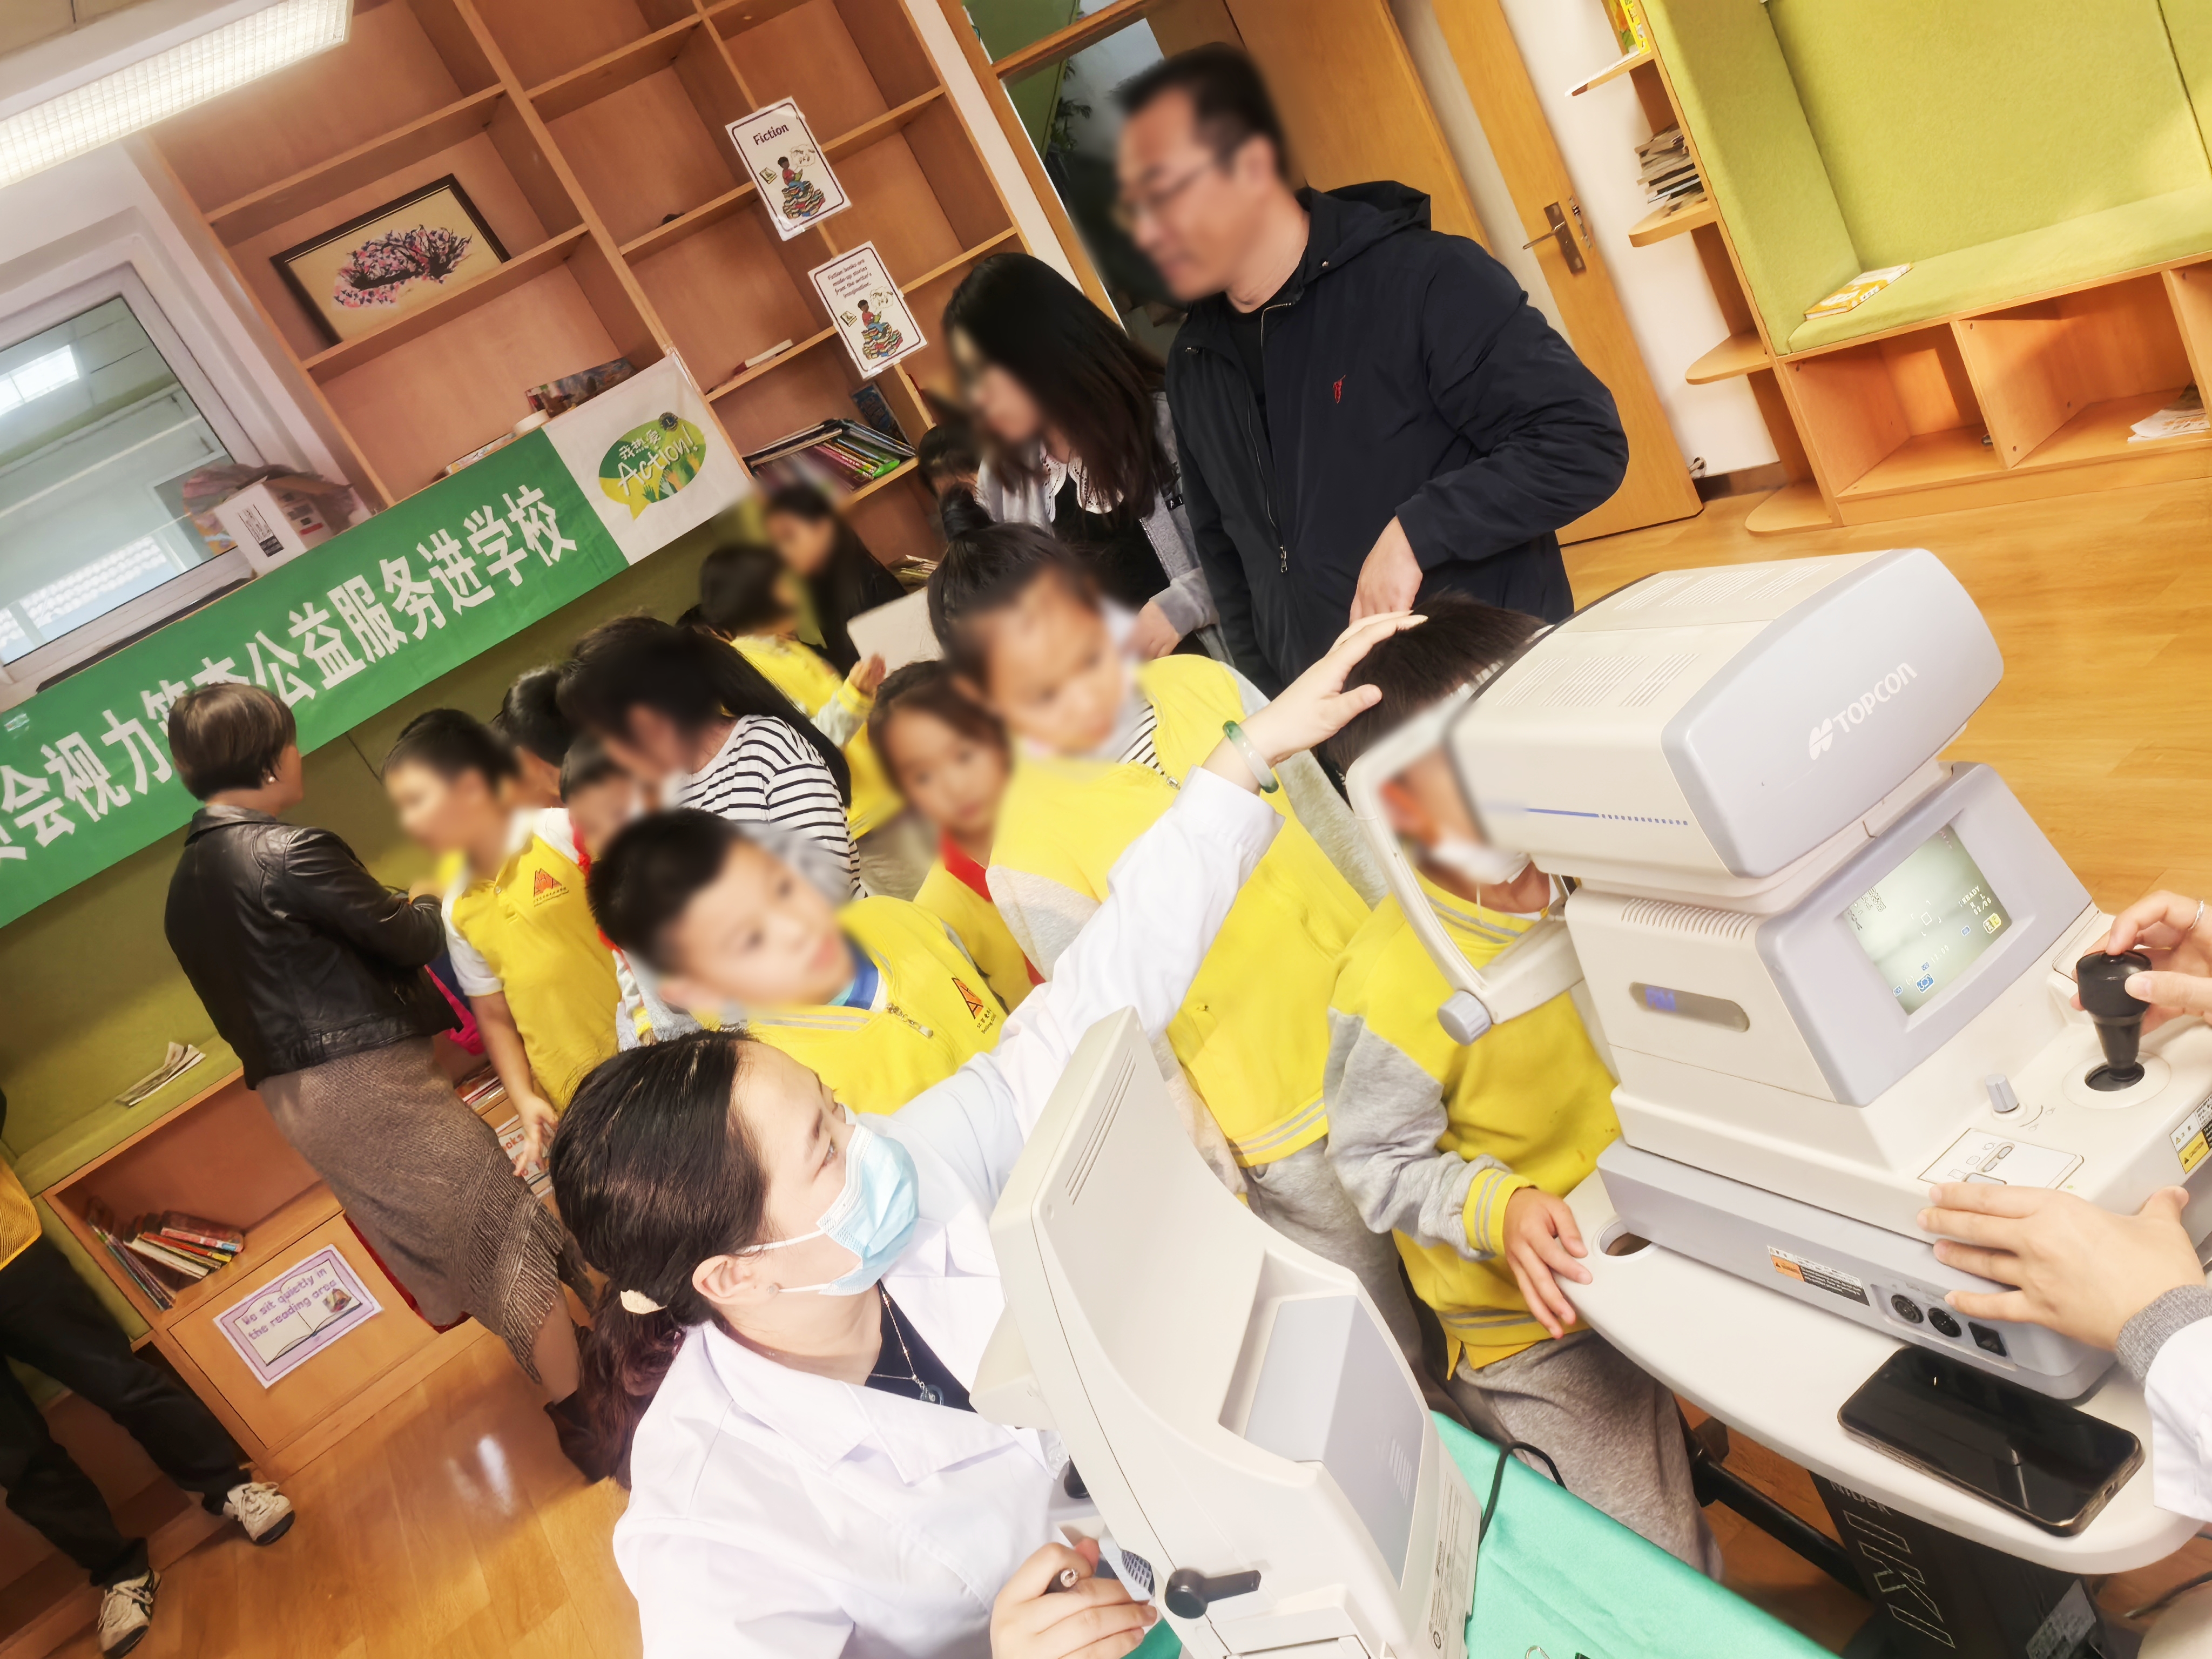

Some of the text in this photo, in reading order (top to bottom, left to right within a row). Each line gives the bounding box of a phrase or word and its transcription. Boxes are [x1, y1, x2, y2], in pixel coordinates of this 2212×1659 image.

[753, 125, 790, 145] Fiction
[1832, 662, 1918, 733] TOPCON
[248, 1279, 337, 1340] the reading area
[259, 1300, 276, 1315] sit
[278, 1276, 314, 1303] quietly
[316, 1269, 327, 1278] in
